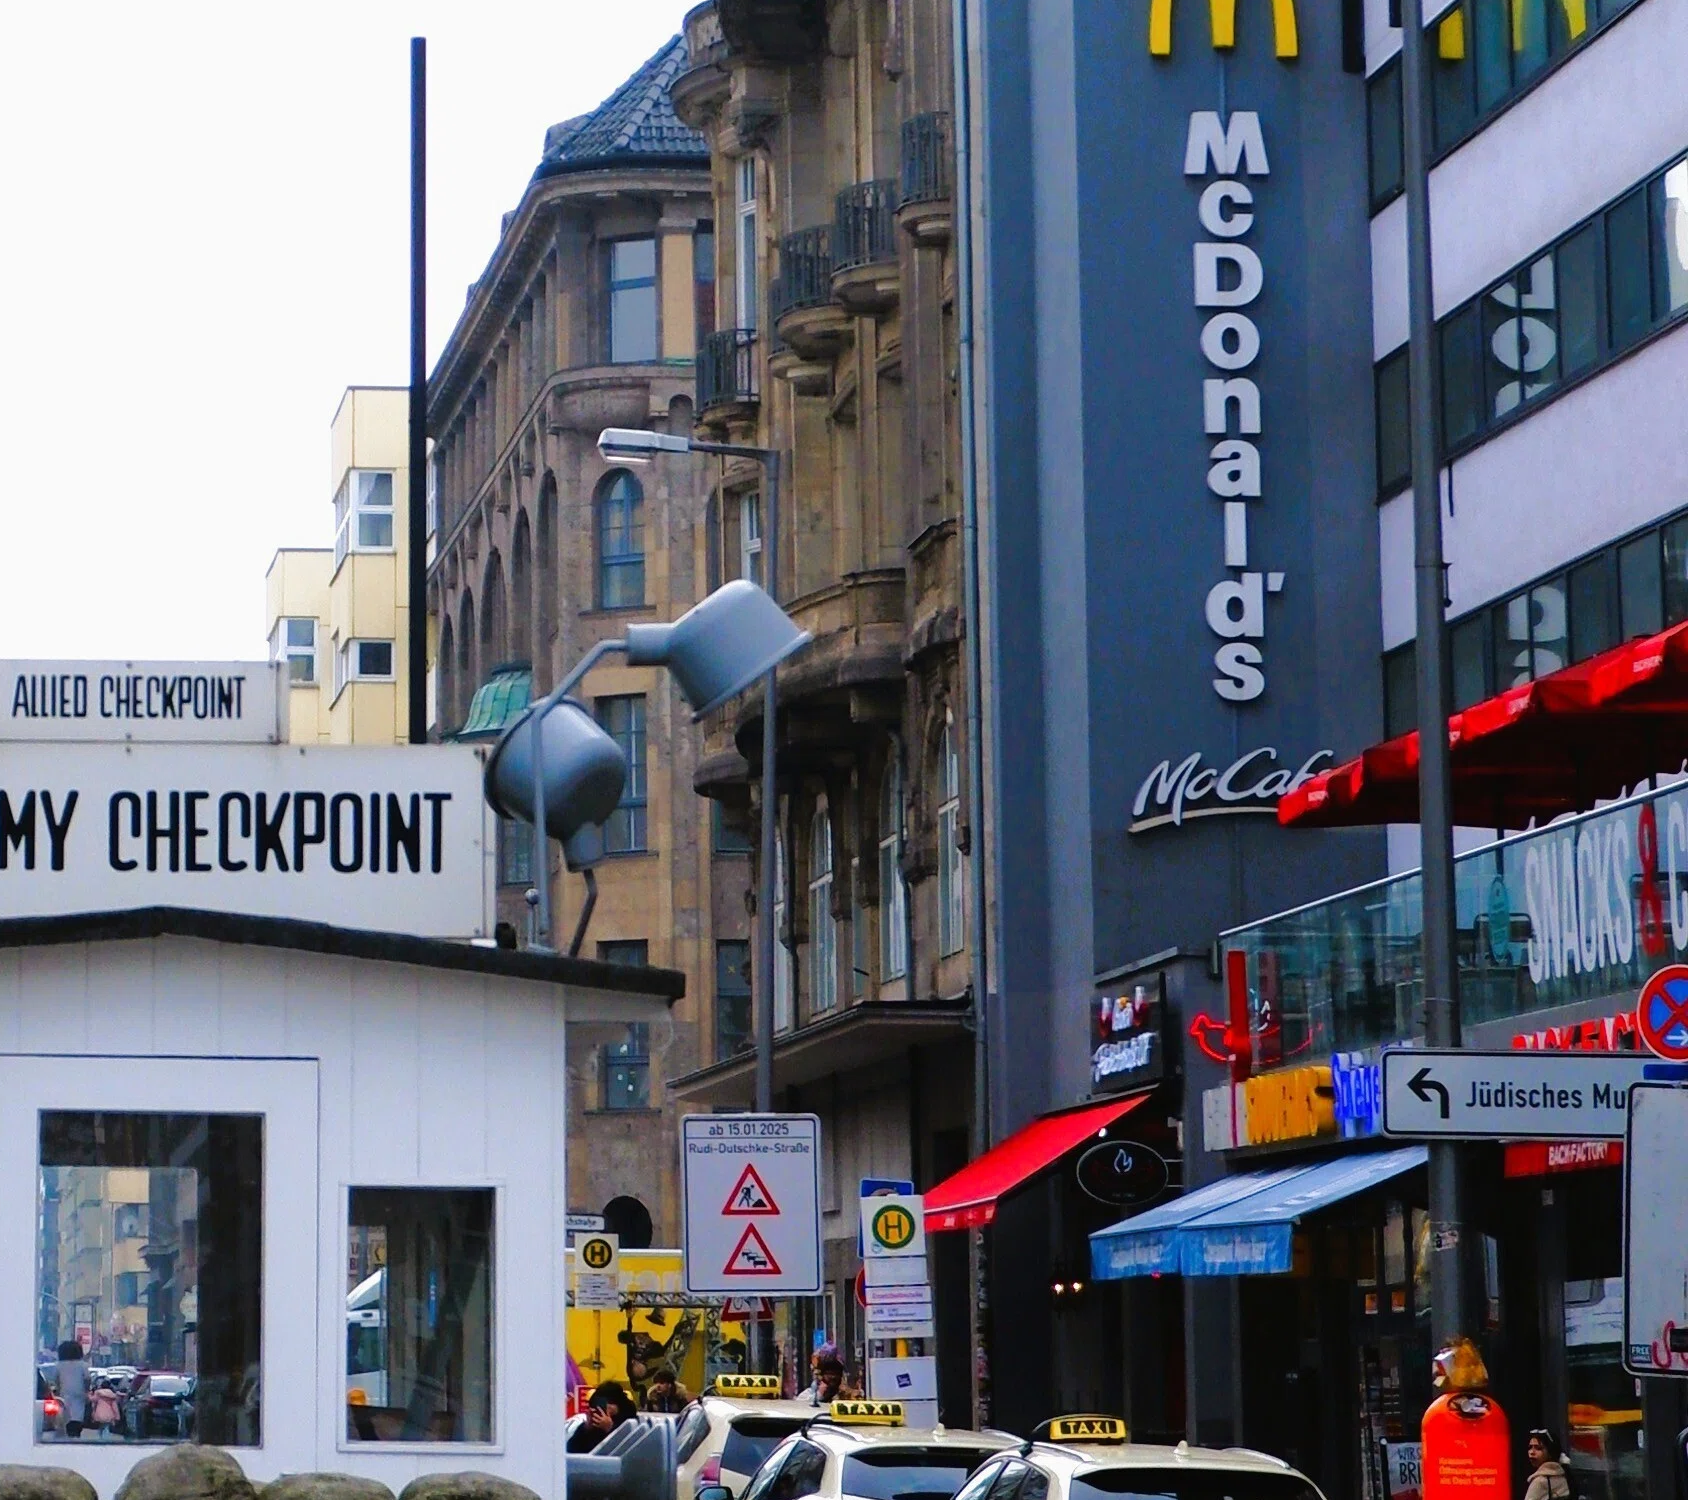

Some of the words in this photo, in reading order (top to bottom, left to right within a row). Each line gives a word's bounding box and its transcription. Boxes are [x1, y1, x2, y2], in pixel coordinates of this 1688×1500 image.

[1184, 110, 1285, 702] McDonald's
[13, 676, 87, 718] ALLIED
[100, 675, 246, 720] CHECKPOINT
[1134, 747, 1334, 816] McCaf
[108, 790, 452, 874] CHECKPOINT
[1524, 820, 1633, 985] SNACKS
[1637, 803, 1665, 957] &
[1466, 1080, 1583, 1110] Jüdisches
[709, 1124, 724, 1136] ab
[728, 1123, 790, 1136] 15.01.2025
[688, 1142, 811, 1154] Rudi-Dutschke-Straße
[728, 1376, 770, 1387] TAXI
[842, 1402, 893, 1416] TAXI
[1066, 1421, 1113, 1435] TAXI
